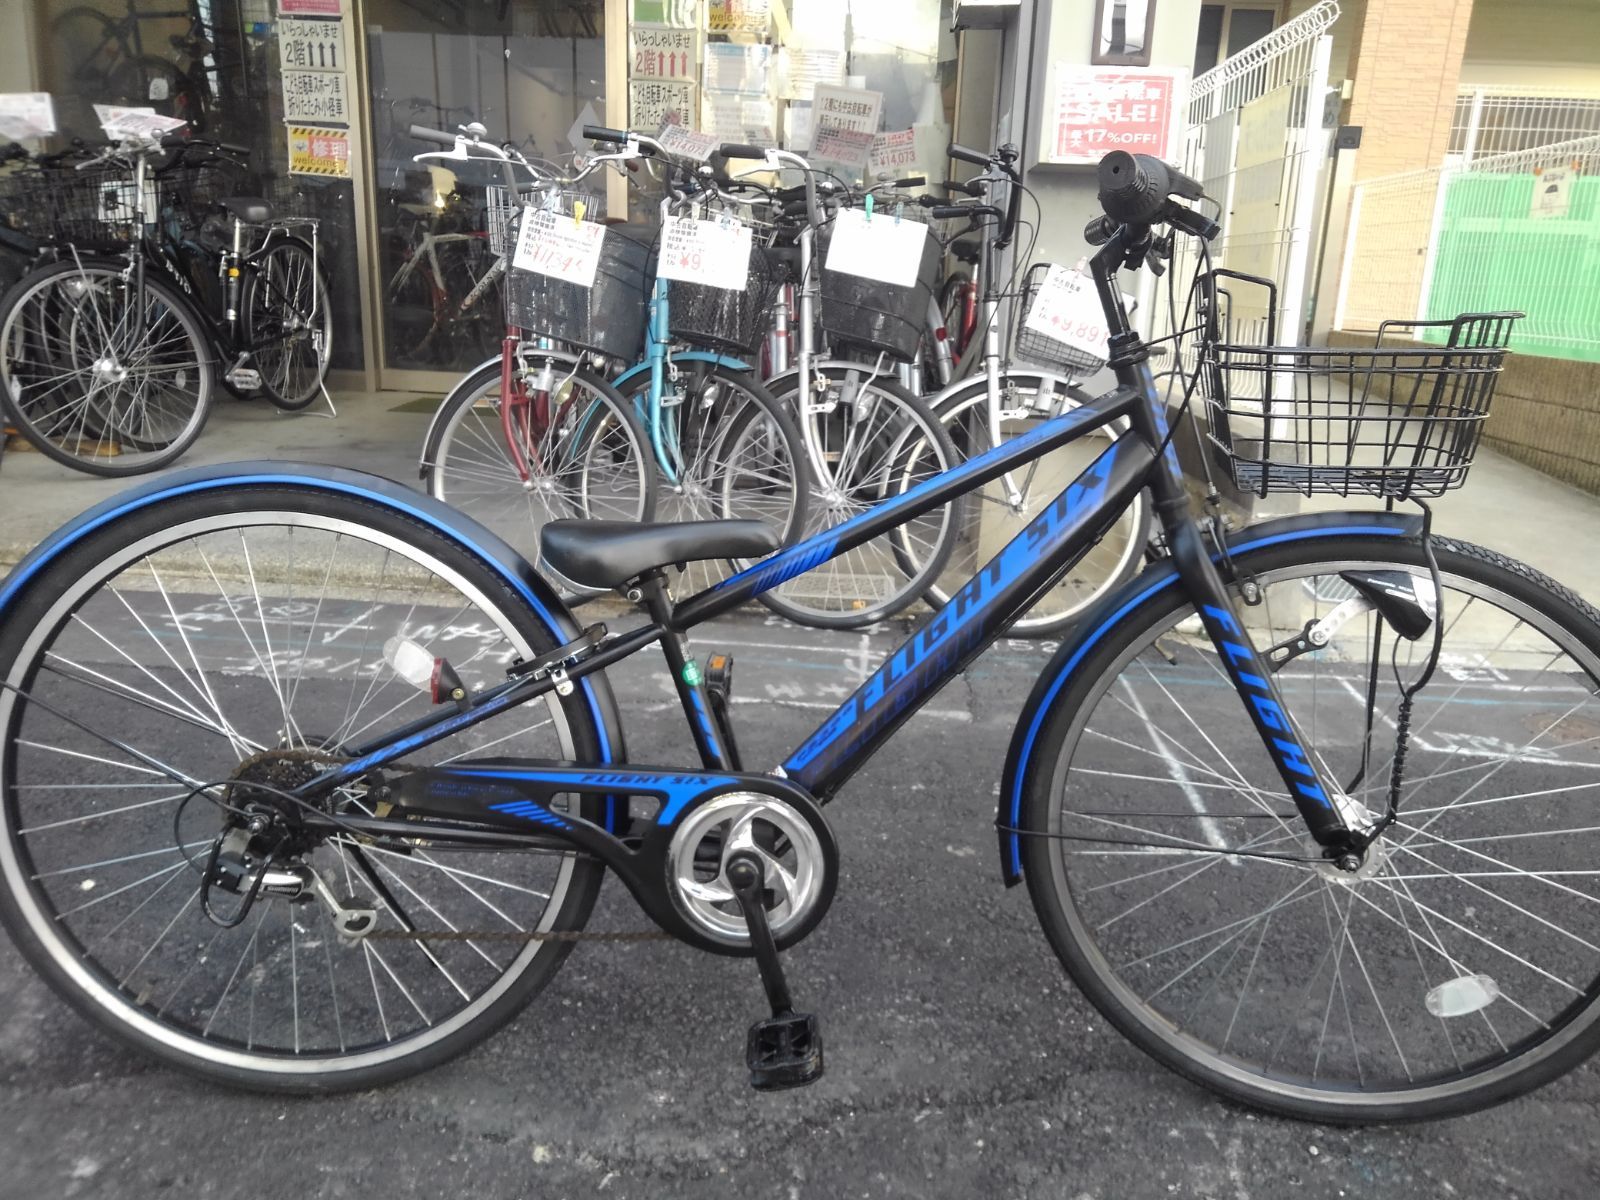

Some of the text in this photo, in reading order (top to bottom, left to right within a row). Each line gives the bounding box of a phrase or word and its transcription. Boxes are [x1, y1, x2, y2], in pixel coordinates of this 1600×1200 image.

[281, 23, 338, 38] いらっしゃいませ
[634, 31, 690, 48] いらっしゃいませ
[285, 39, 305, 66] 2階
[636, 48, 656, 76] 2階
[1084, 129, 1158, 144] 17%OFF!
[854, 550, 1006, 718] FLIGHT
[1026, 467, 1104, 552] SIX
[1202, 604, 1332, 810] FLIGHT
[580, 773, 713, 786] FLIGHT SIX
